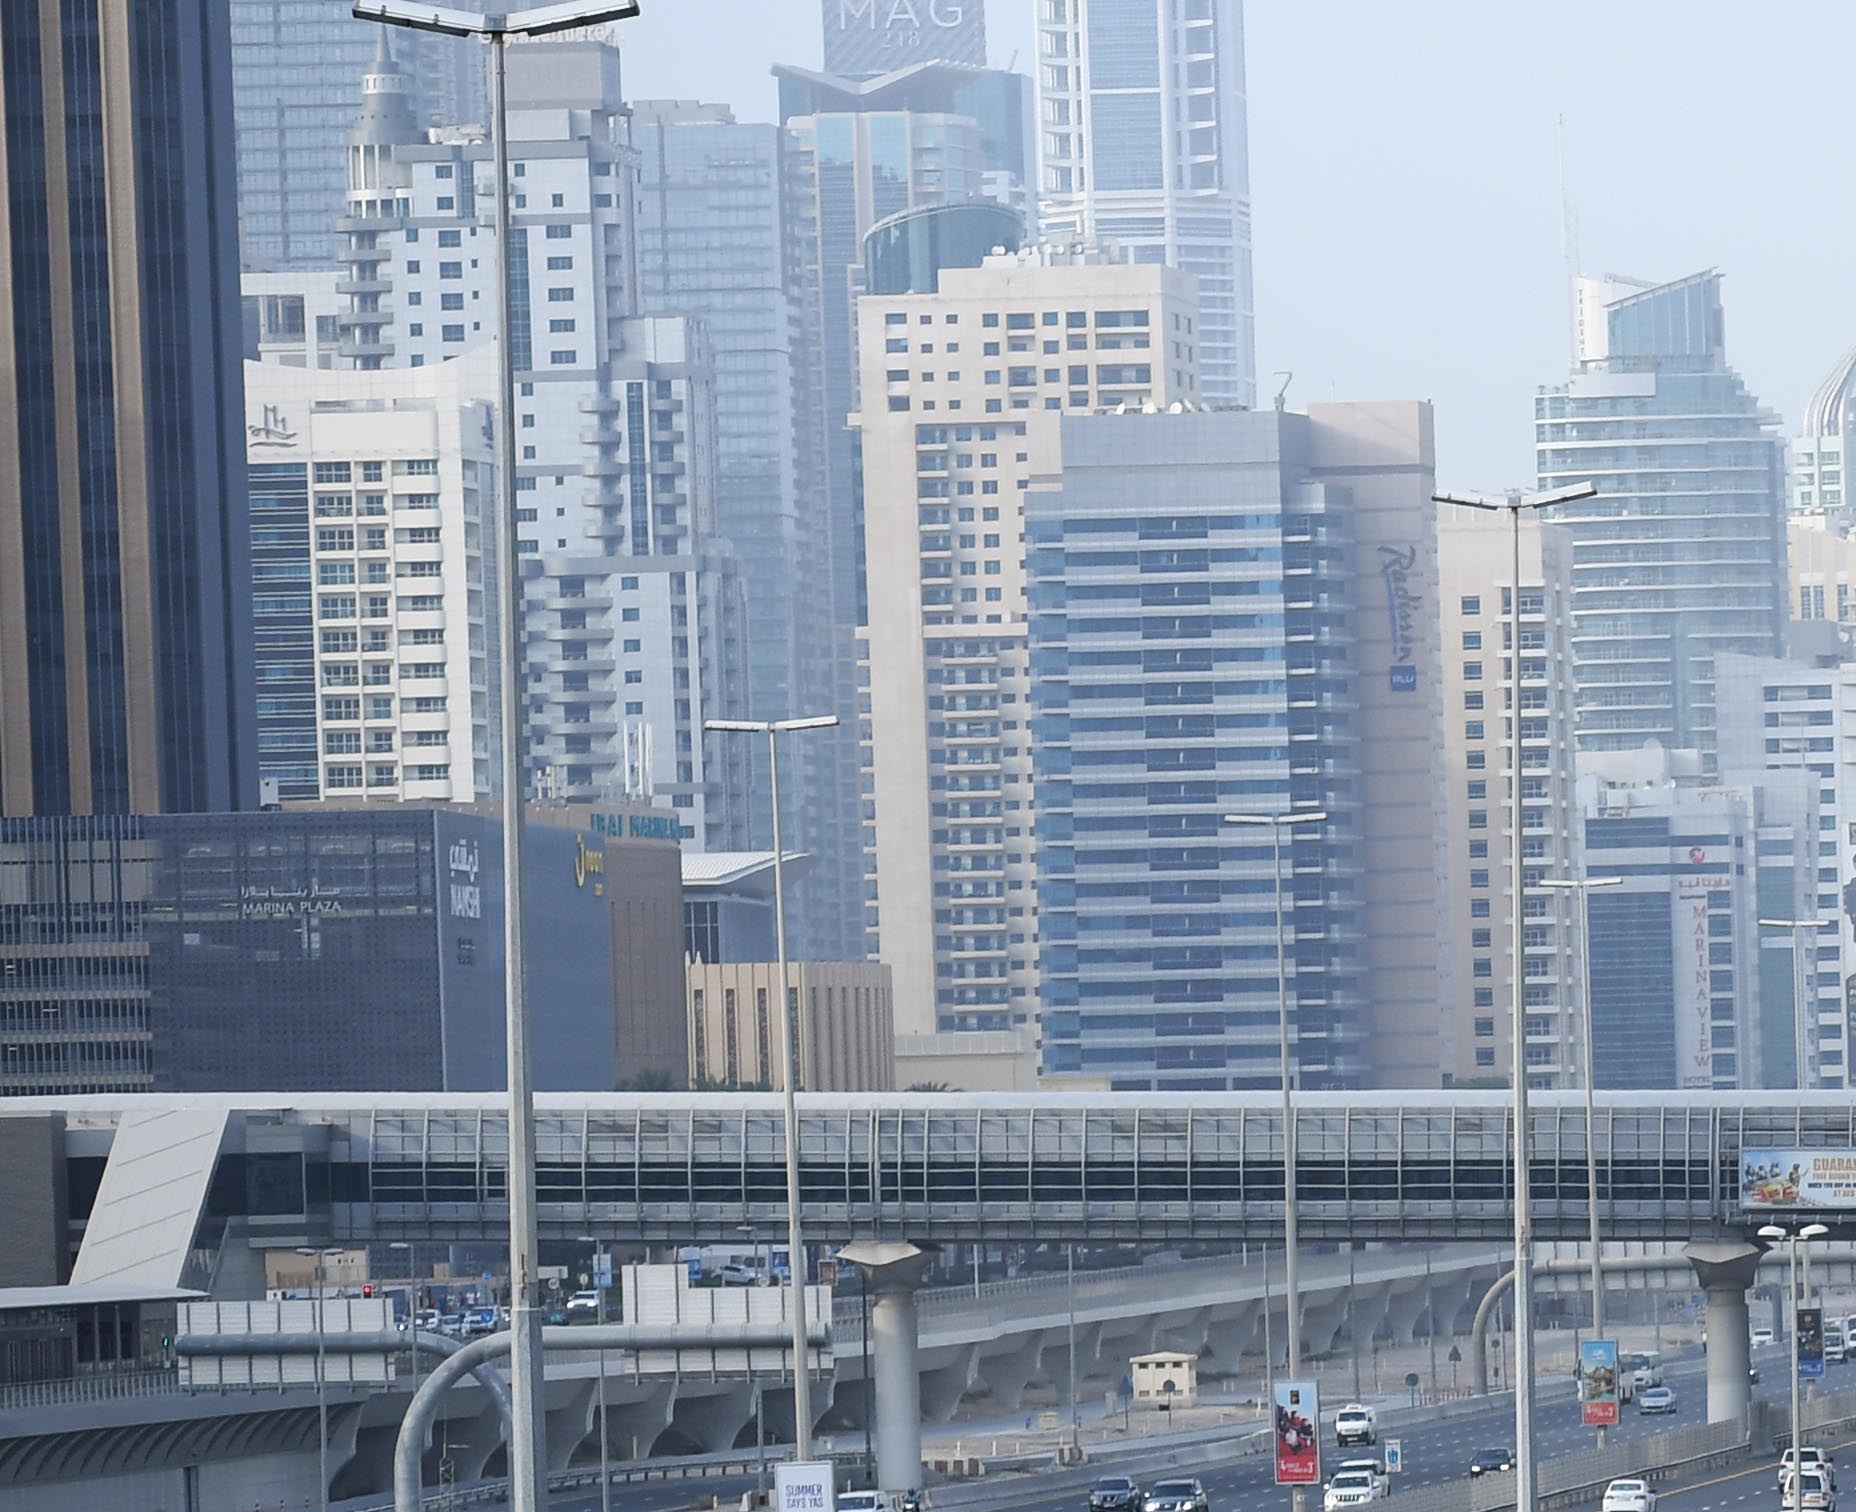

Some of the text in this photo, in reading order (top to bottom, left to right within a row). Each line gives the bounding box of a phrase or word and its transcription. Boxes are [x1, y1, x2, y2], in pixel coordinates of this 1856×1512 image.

[840, 0, 962, 30] MAG
[242, 901, 342, 914] MARINA PLAZA
[786, 1484, 823, 1497] SUMMER
[808, 1498, 824, 1508] YAS
